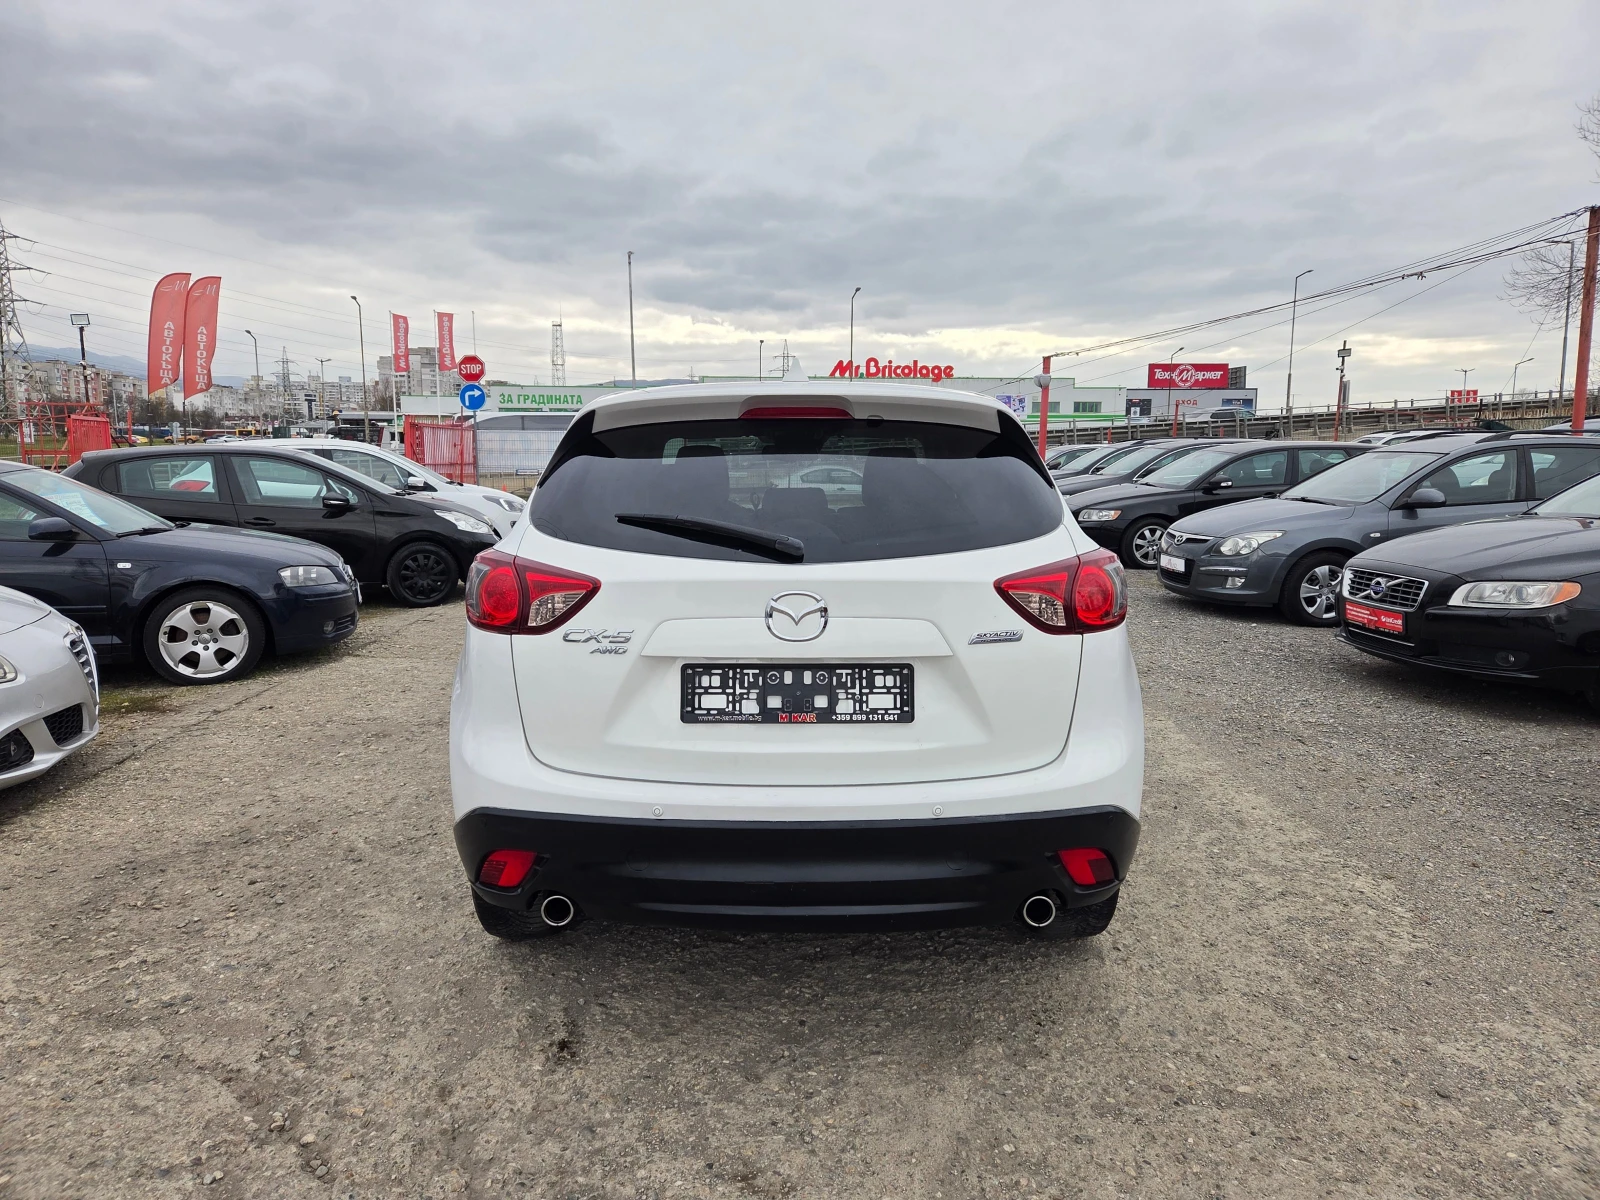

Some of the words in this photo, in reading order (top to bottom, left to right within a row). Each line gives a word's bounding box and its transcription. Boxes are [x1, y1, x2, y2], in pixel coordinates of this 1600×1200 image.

[160, 321, 175, 384] АВТОКЪЩА
[195, 326, 208, 389] АВТОКЪЩА
[460, 364, 482, 374] STOP
[499, 393, 514, 404] ЗА
[517, 394, 583, 406] ГРАДИНАТА
[562, 628, 635, 644] CX-5
[589, 645, 629, 655] AWD
[778, 714, 789, 723] M
[792, 713, 817, 723] KAR
